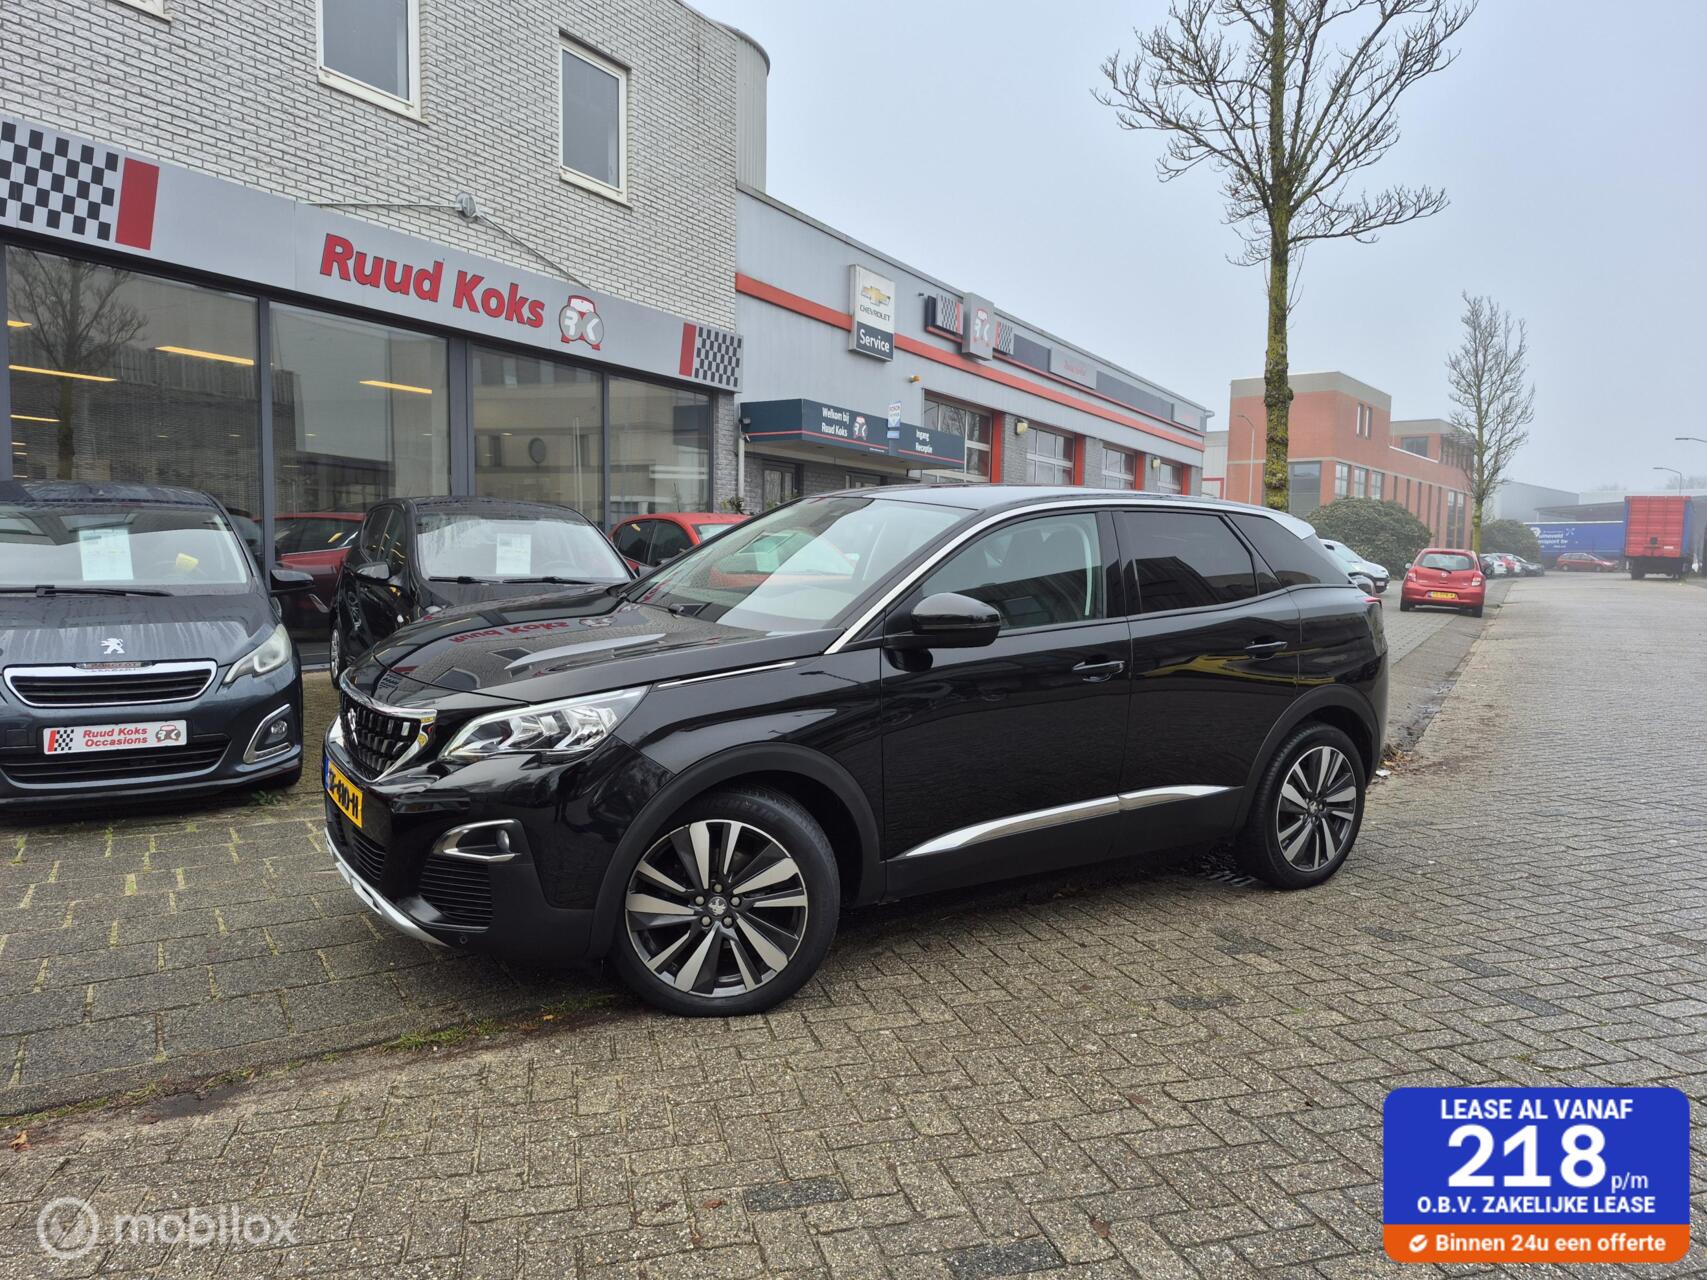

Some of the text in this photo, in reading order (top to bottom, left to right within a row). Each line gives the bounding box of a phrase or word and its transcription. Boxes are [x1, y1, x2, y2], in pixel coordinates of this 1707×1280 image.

[319, 233, 545, 328] Ruud Koks
[859, 304, 890, 322] CHEVROLET
[860, 328, 890, 353] Service
[822, 407, 850, 424] Welkom bij
[821, 422, 848, 437] Ruud Koks
[83, 727, 148, 739] Ruud Koks
[85, 736, 149, 747] Occasions
